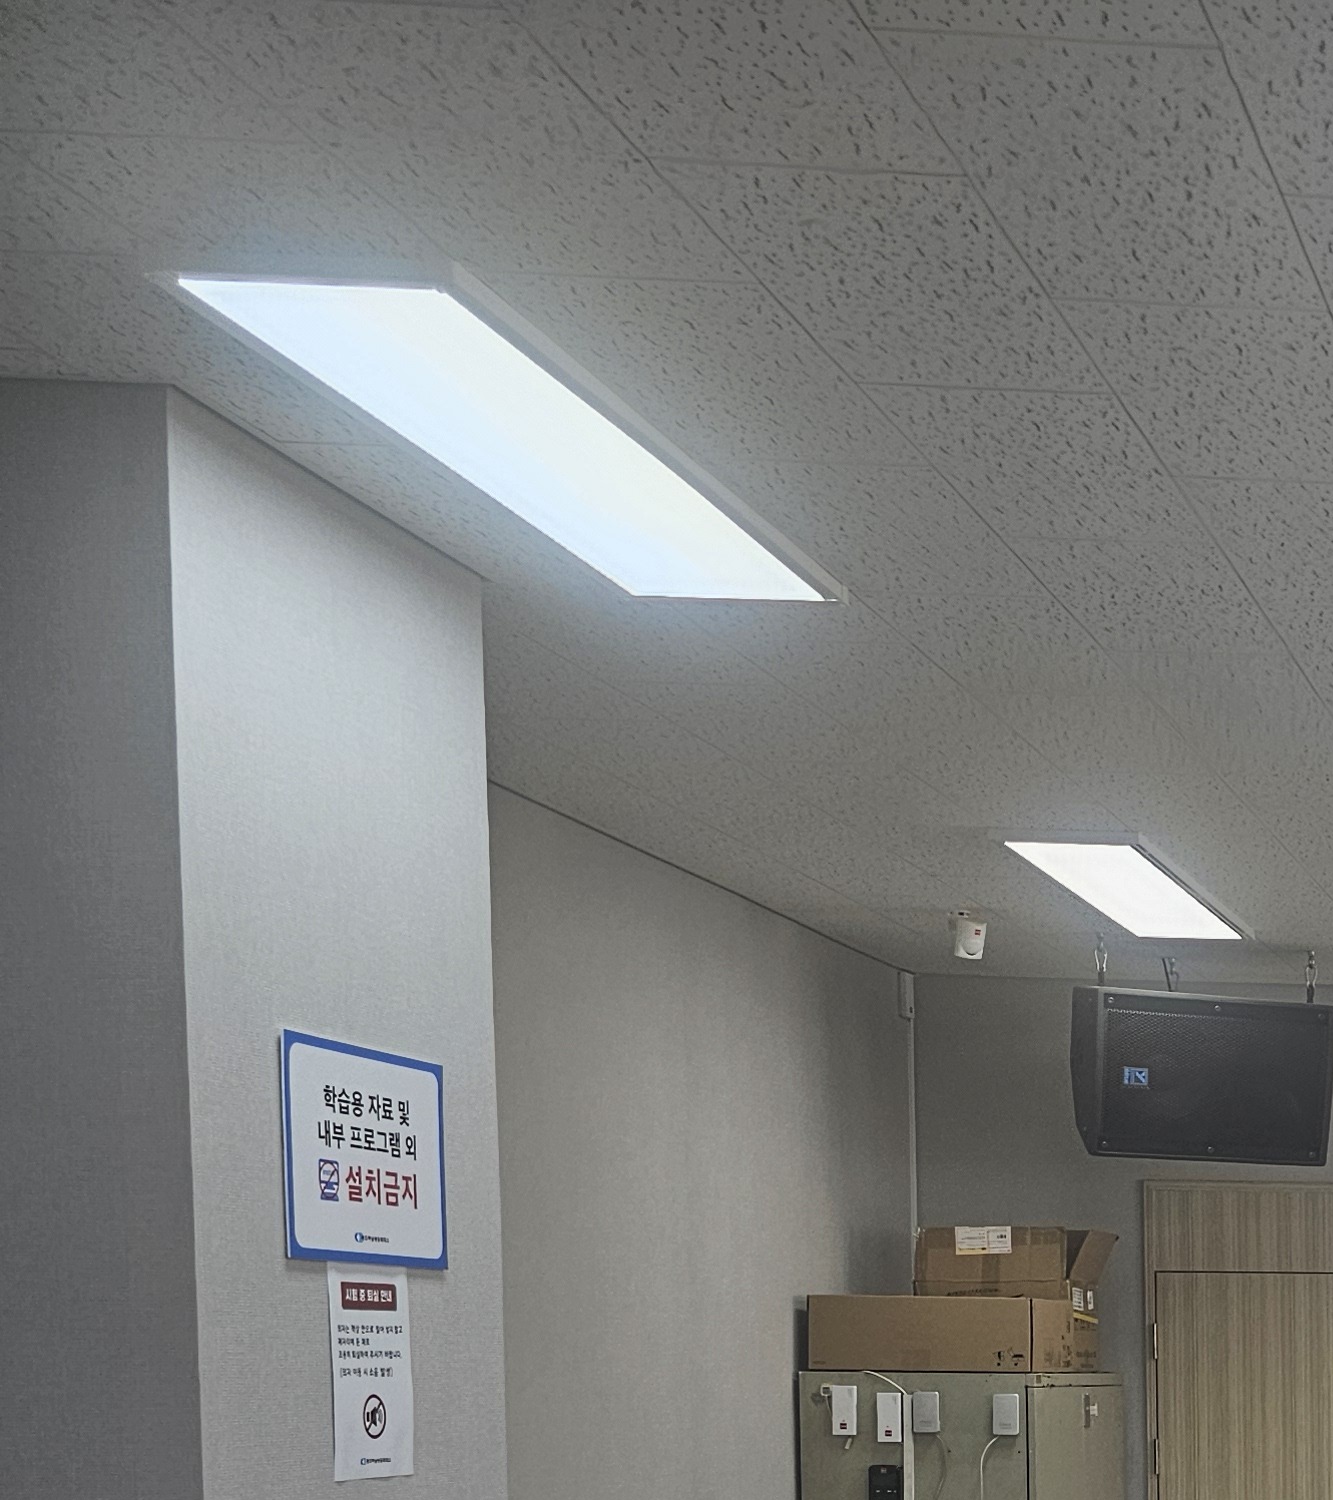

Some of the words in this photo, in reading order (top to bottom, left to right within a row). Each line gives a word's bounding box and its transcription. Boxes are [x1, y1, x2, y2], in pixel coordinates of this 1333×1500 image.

[323, 1085, 364, 1117] 학습용
[369, 1094, 394, 1121] 자료
[398, 1100, 410, 1127] 및
[318, 1120, 345, 1149] 내부
[350, 1126, 401, 1158] 프로그램
[405, 1135, 417, 1161] 외
[345, 1166, 418, 1210] 설치금지
[346, 1288, 358, 1301] 시험
[359, 1289, 365, 1302] 중
